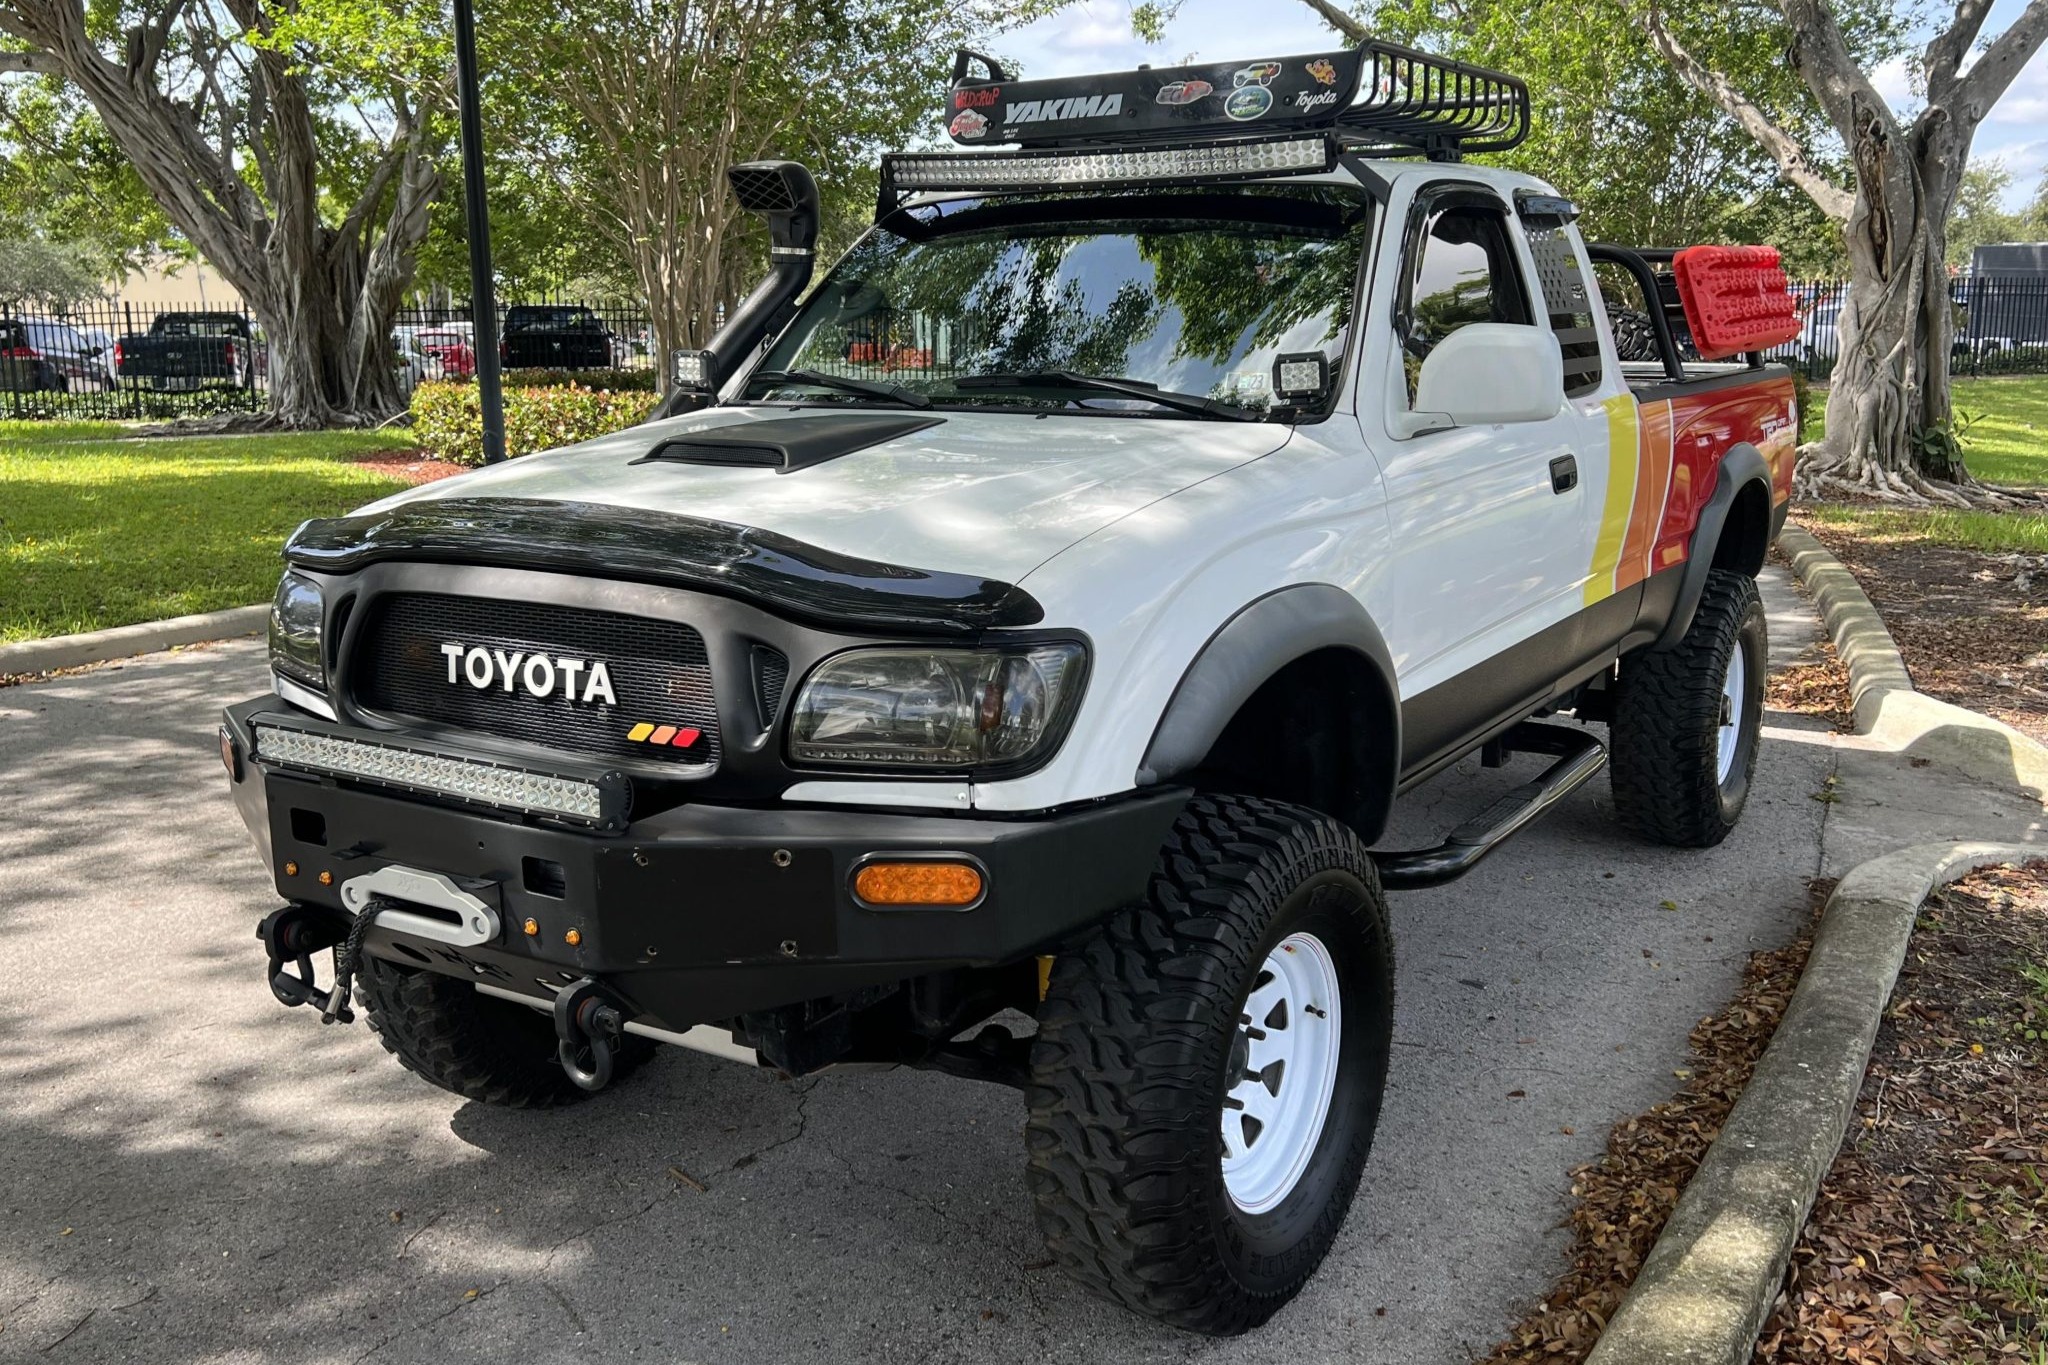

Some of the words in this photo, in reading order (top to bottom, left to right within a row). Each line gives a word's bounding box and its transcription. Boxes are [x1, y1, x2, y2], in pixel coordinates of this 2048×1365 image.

[1003, 93, 1123, 124] YAKIMA
[1295, 90, 1337, 113] Toyota
[441, 642, 617, 705] TOYOTA
